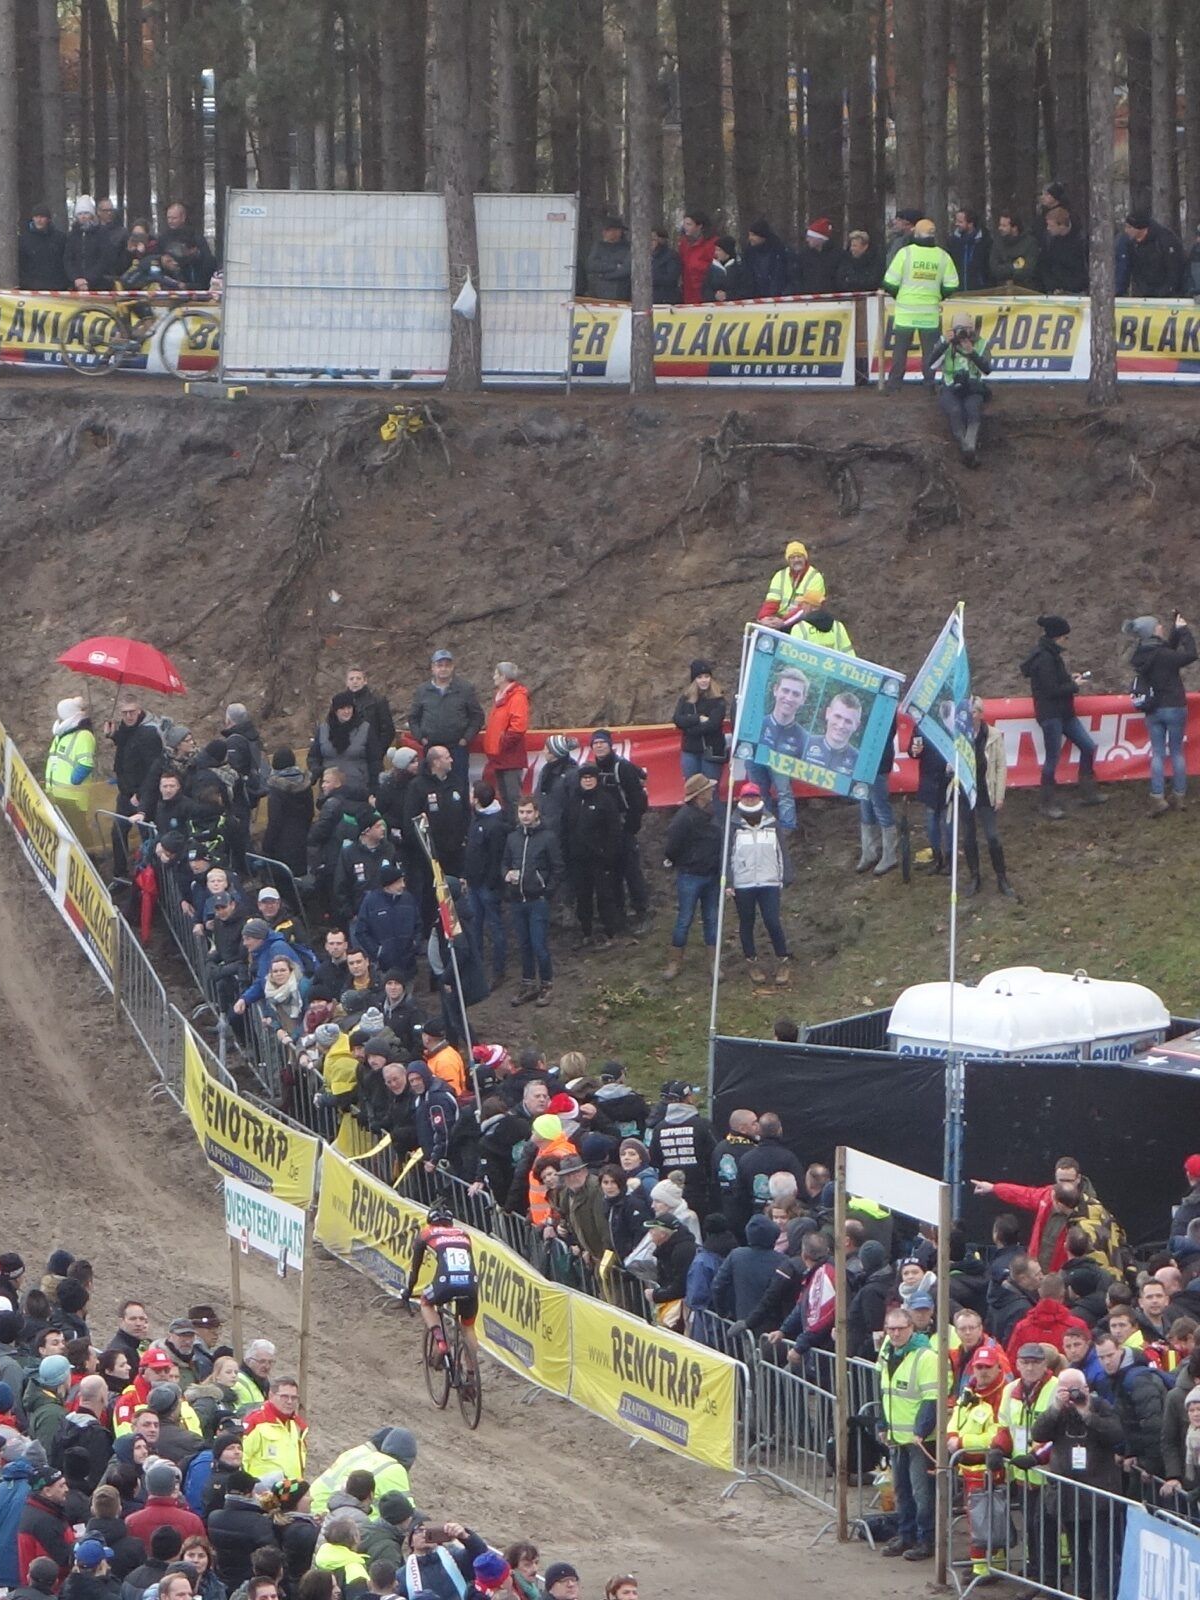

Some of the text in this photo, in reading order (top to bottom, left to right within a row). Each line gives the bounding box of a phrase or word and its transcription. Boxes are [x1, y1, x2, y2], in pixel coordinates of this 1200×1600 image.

[912, 260, 939, 271] CREW
[652, 313, 843, 356] BLÅKLÄDER
[730, 364, 819, 375] WORKWEAR
[780, 640, 880, 689] Toon & Thijs
[660, 1126, 694, 1137] SUPPORTER
[226, 1187, 304, 1259] OVERSTEEKPLAATS
[449, 1252, 467, 1265] 13
[478, 1250, 542, 1334] RENOTRAP
[611, 1325, 703, 1410] RENOTRAP
